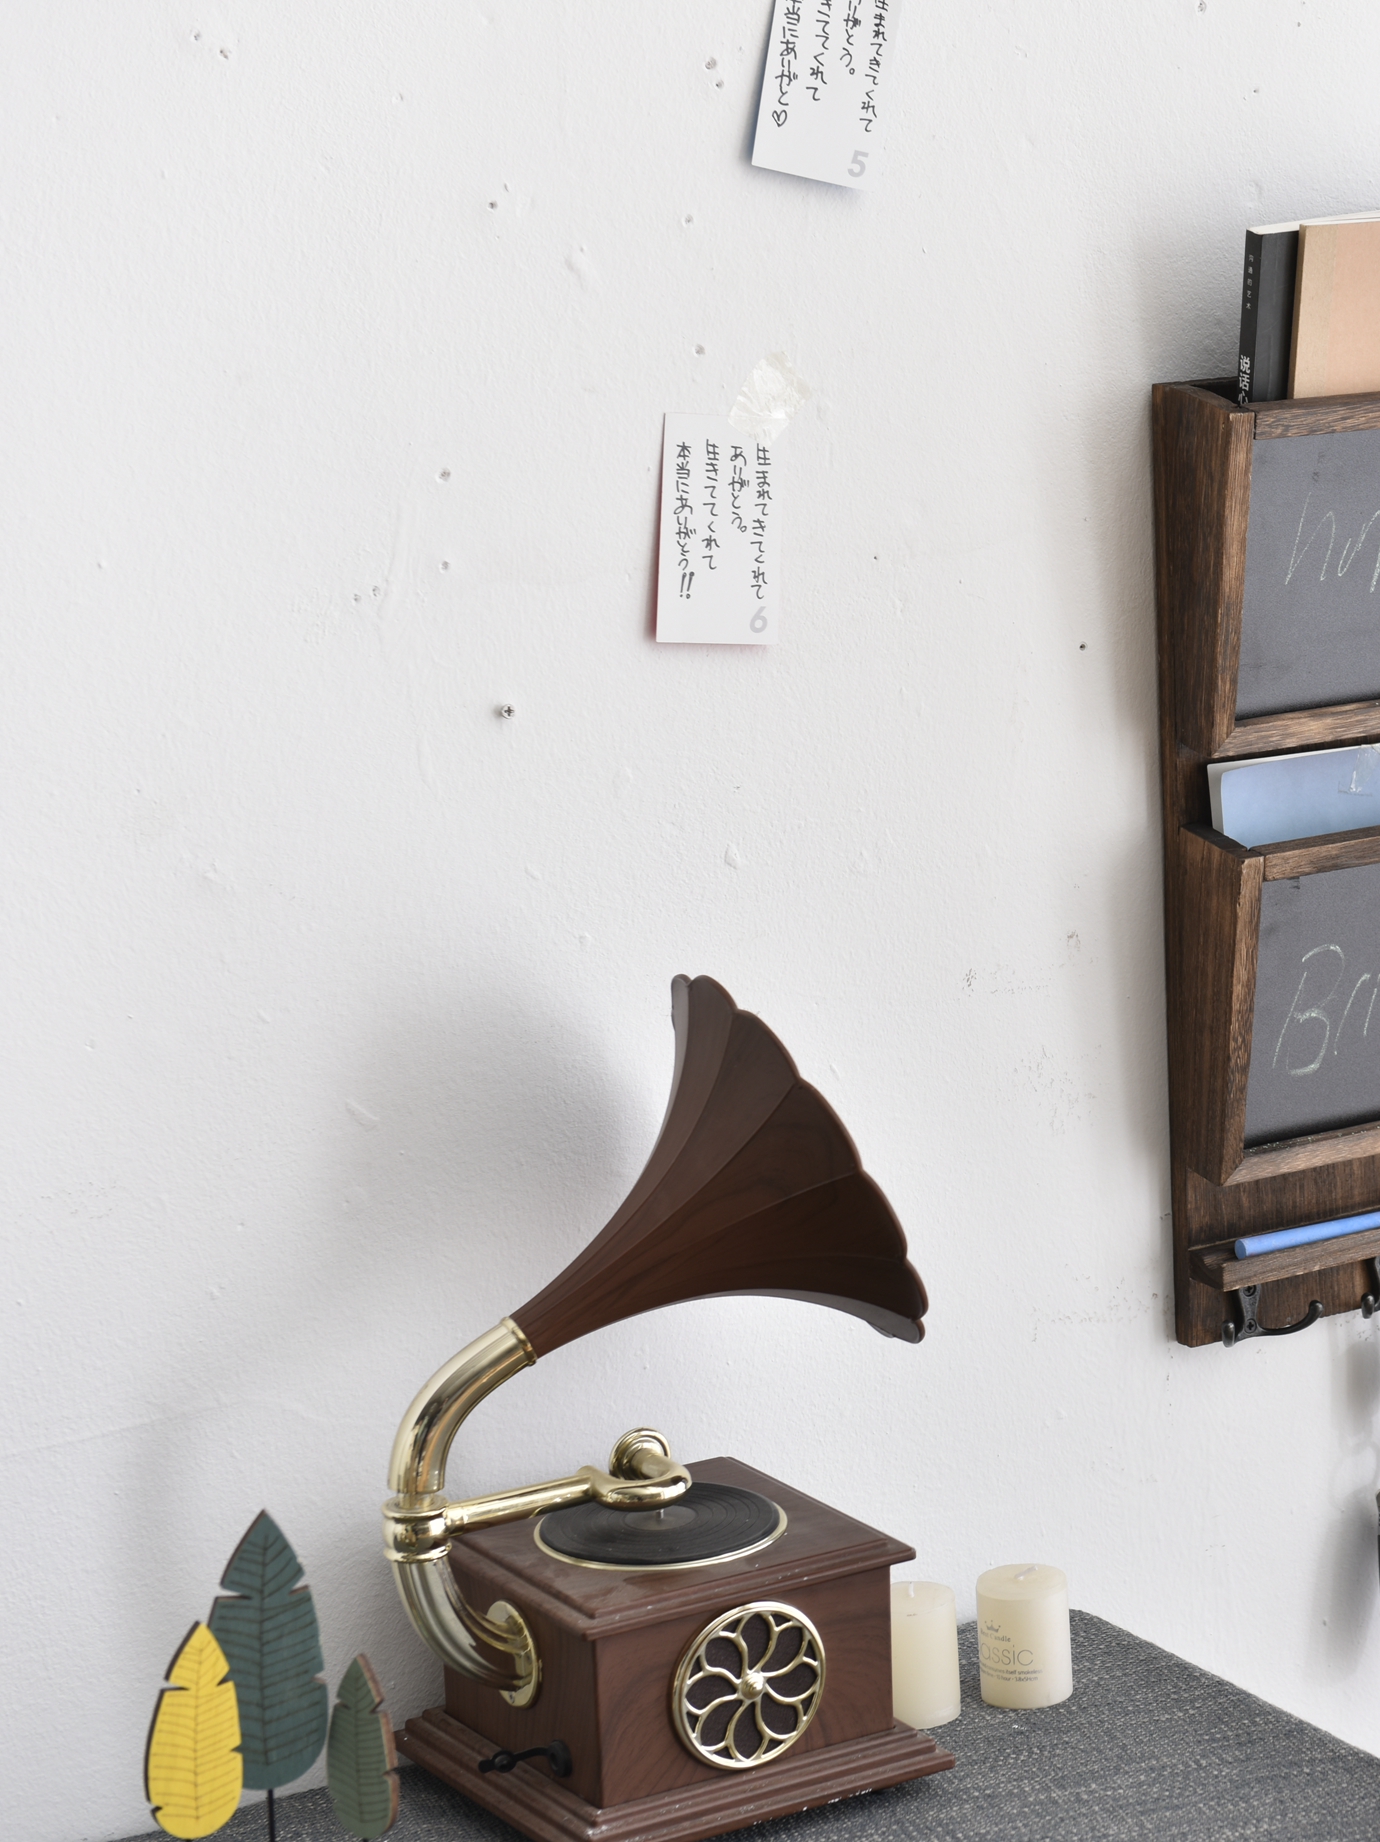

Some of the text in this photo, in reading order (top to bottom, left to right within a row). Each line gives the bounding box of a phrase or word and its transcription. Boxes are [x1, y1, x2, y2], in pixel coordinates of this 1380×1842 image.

[840, 0, 862, 75] りがとう。
[847, 150, 869, 178] 5
[702, 439, 720, 570] 生きててくれて
[728, 445, 749, 533] ありがとう。
[750, 443, 772, 600] 生まれてきてくれて
[749, 606, 768, 634] 6
